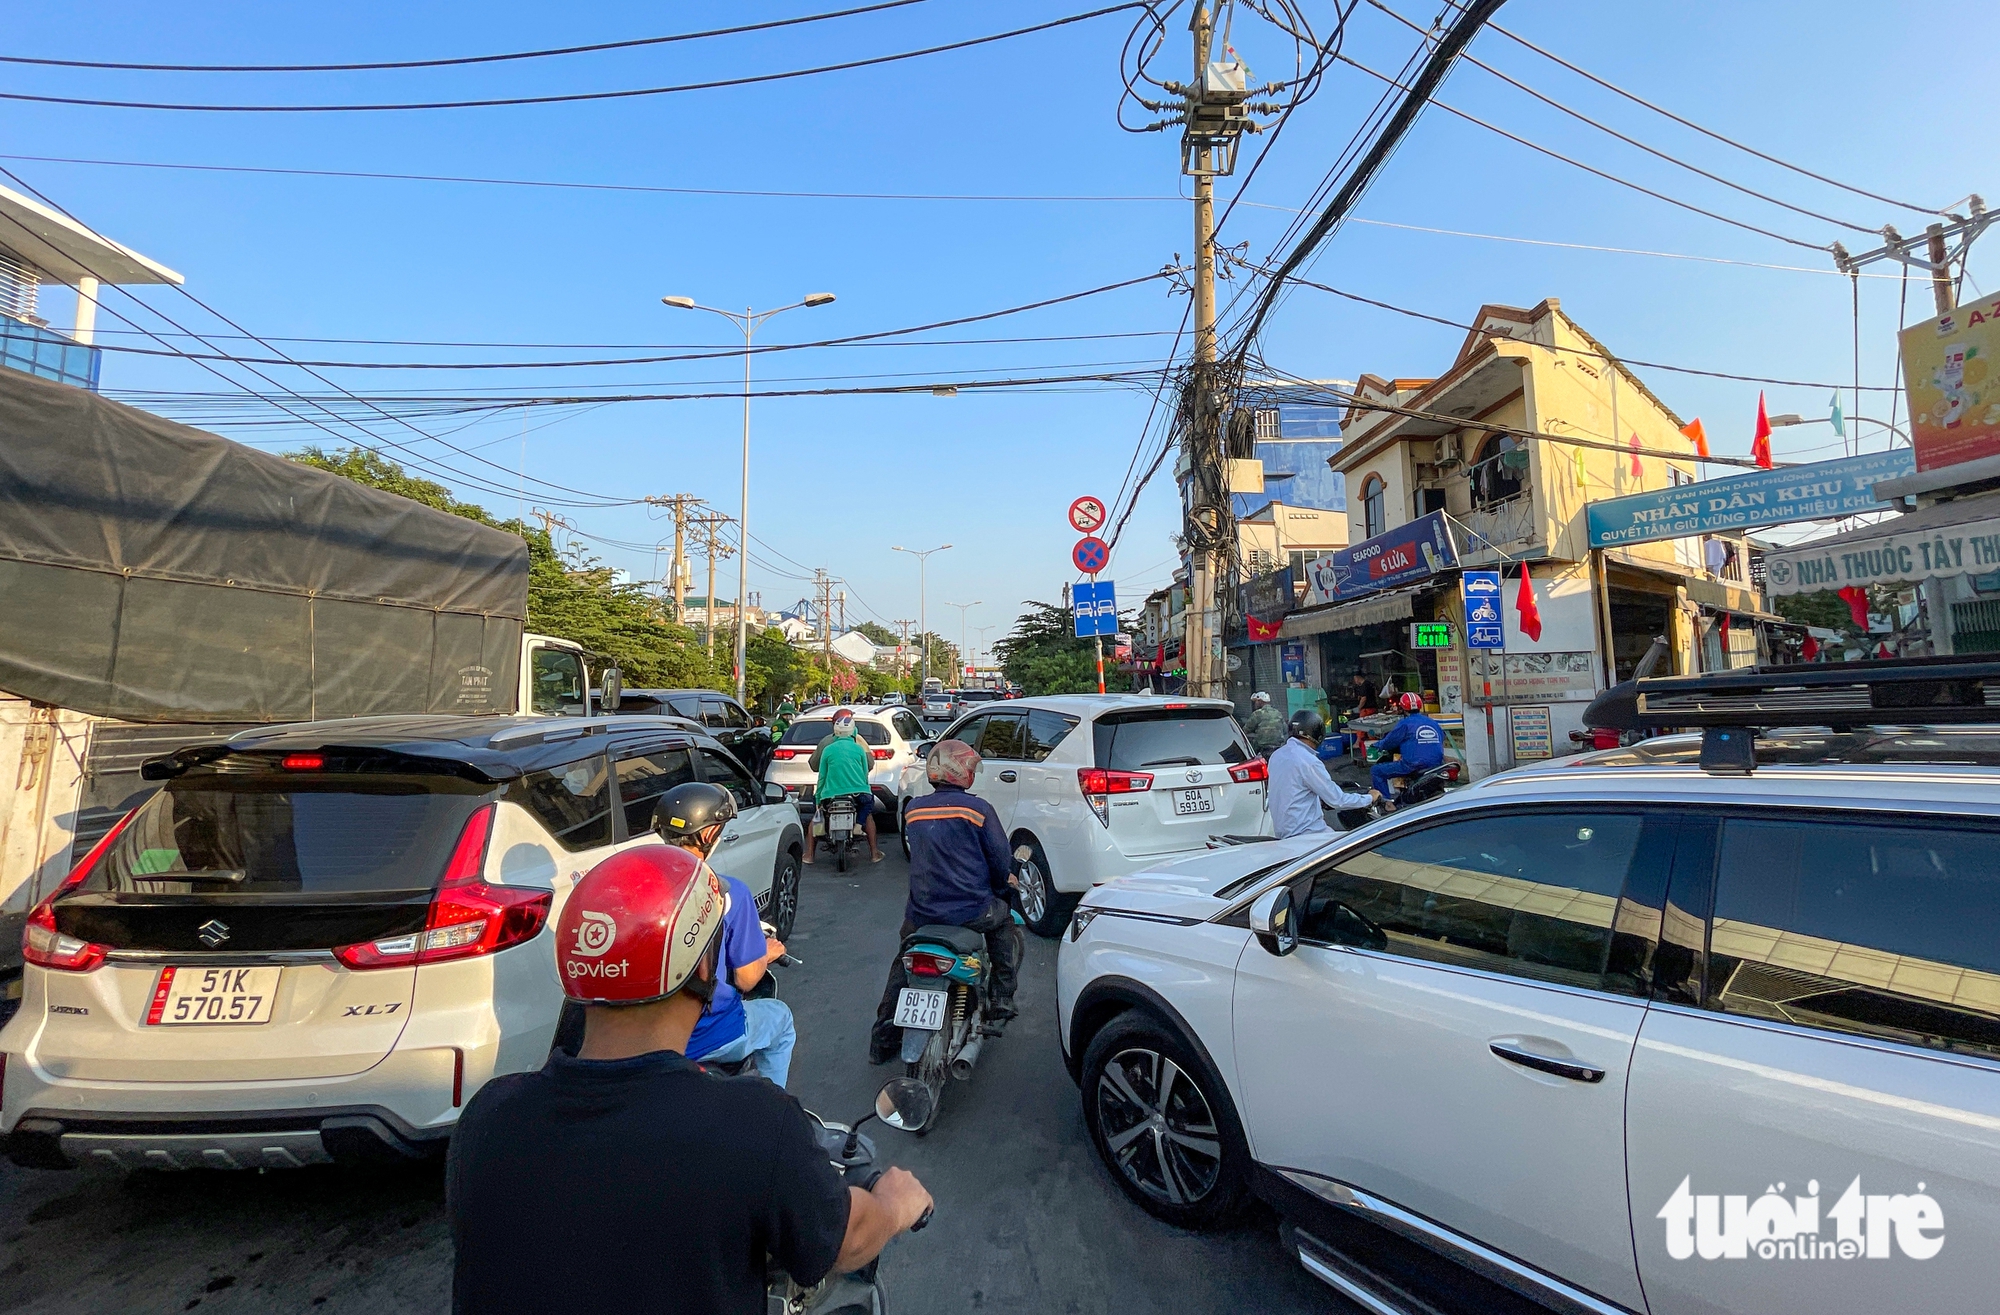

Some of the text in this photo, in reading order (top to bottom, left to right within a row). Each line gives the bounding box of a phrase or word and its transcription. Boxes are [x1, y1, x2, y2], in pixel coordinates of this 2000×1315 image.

[1675, 491, 1696, 500] BAN
[1699, 485, 1730, 496] NHÂN
[1733, 480, 1759, 491] DÂN
[1632, 502, 1700, 524] NHÂN
[1708, 492, 1766, 512] DÂN
[1776, 479, 1843, 502] KHU
[1601, 522, 1641, 541] QUYẾT
[1644, 522, 1671, 536] TÂM
[1674, 516, 1700, 531] GIỮ
[1702, 510, 1746, 526] VỮNG
[1750, 505, 1794, 521] DANH
[1799, 497, 1838, 516] HIỆU
[1352, 544, 1382, 563] SEAFOOD
[1380, 549, 1409, 573] 6 LỬA
[1797, 551, 1838, 586] NHÀ
[1841, 537, 1913, 580] THUỐC
[1918, 533, 1964, 570] TÂY
[1184, 790, 1202, 801] 60A
[1179, 800, 1211, 813] 593.05
[683, 892, 715, 948] goviet
[566, 959, 630, 979] goviet
[201, 969, 251, 993] 51K
[173, 996, 263, 1020] 570.57
[341, 1002, 403, 1017] XL7
[905, 991, 940, 1009] 60-Y6
[901, 1007, 937, 1026] 2640
